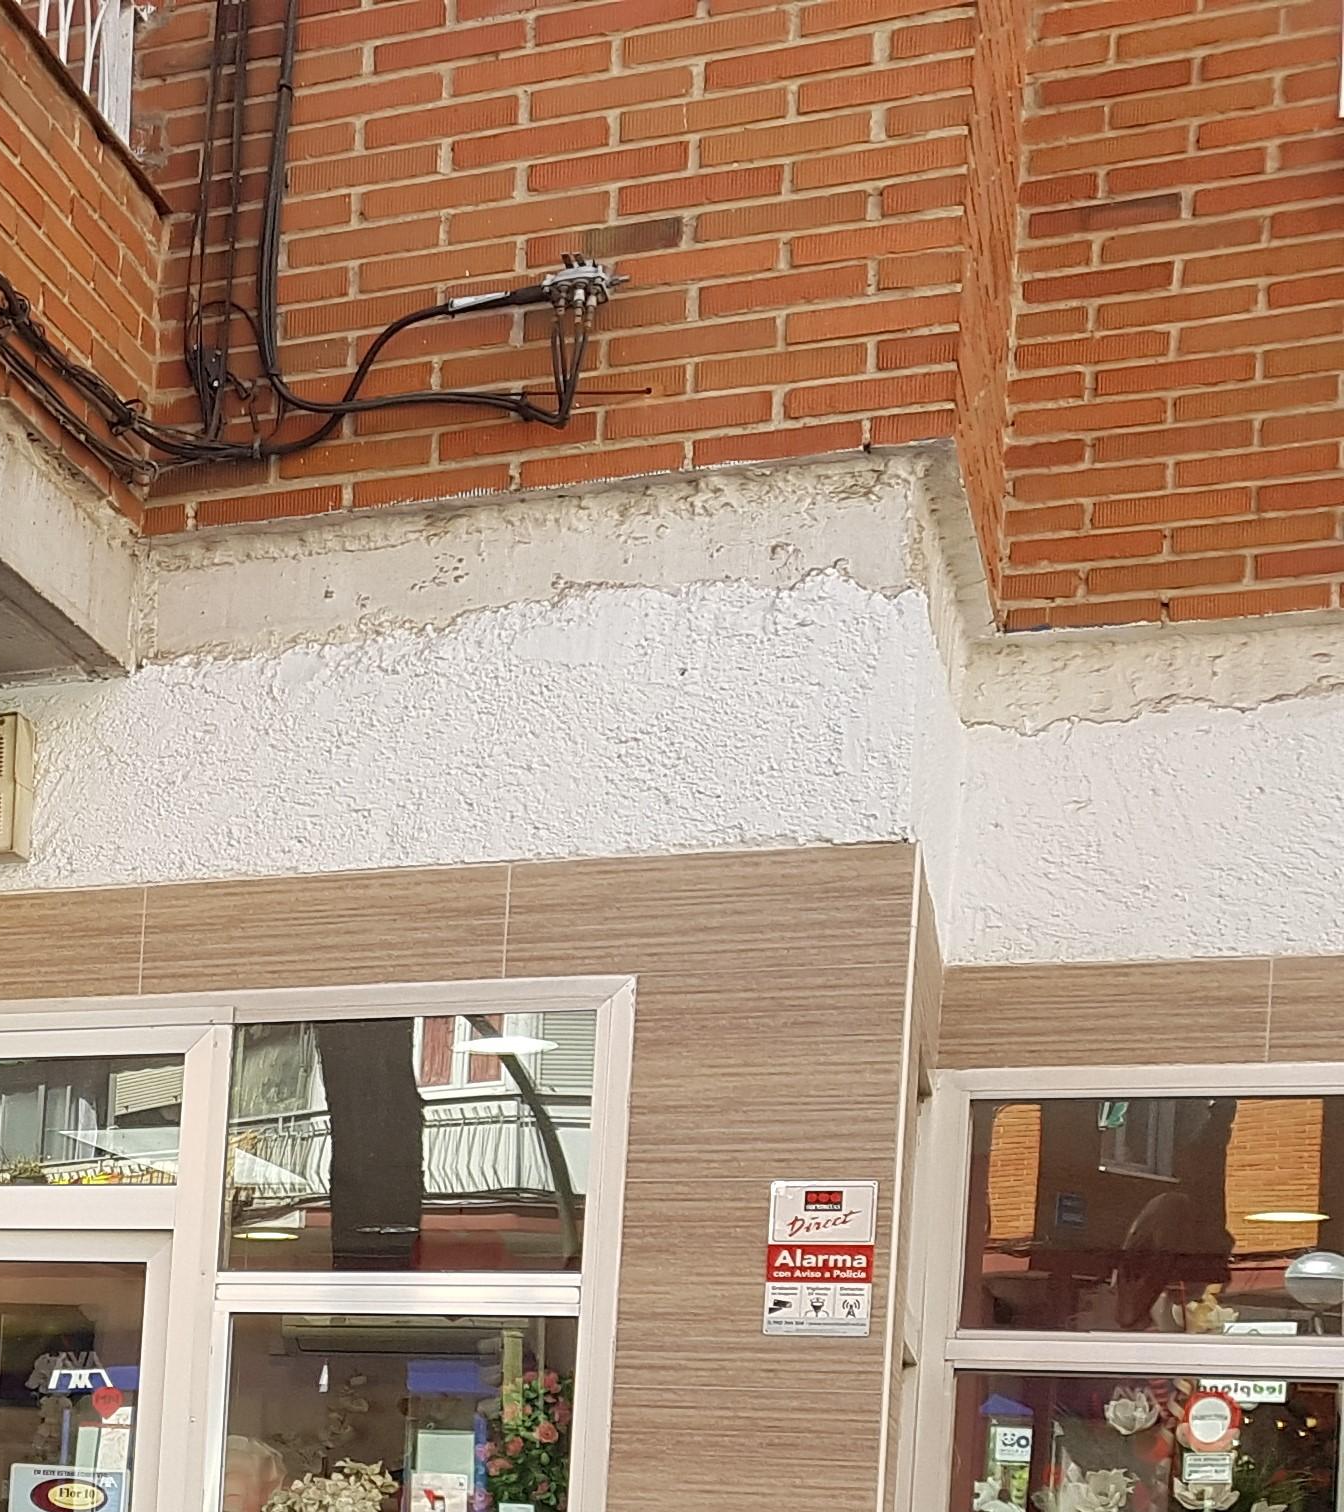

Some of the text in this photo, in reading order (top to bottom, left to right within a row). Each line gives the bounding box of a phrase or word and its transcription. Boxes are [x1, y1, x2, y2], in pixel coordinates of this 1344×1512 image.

[786, 1210, 862, 1238] Direct
[774, 1248, 868, 1268] Alarma
[793, 1269, 822, 1279] Aviso
[58, 1487, 82, 1499] Flor
